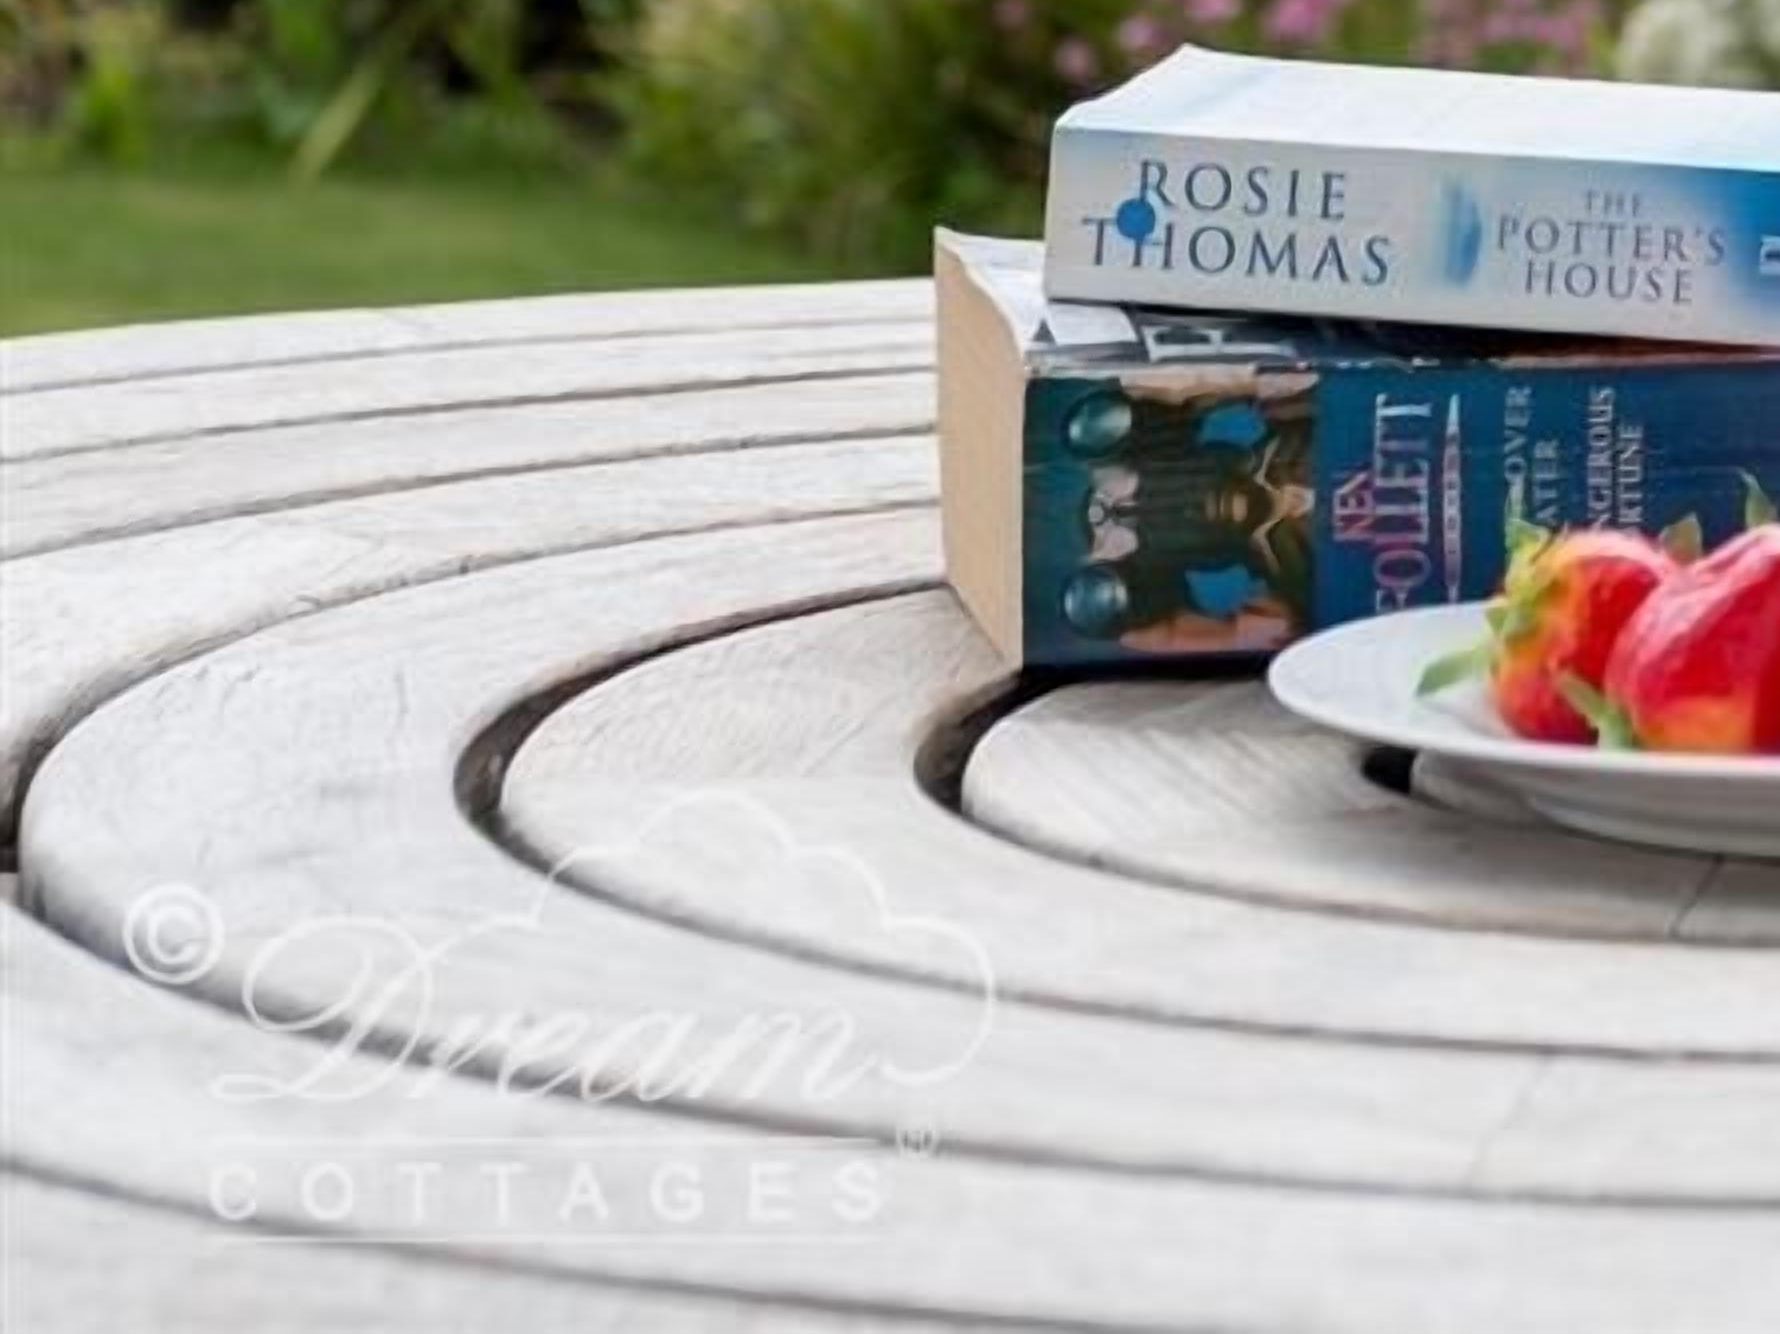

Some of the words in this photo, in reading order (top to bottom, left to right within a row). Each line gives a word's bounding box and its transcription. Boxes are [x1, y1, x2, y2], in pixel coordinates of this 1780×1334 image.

[1138, 159, 1346, 221] ROSIE
[1584, 190, 1642, 214] THE
[1081, 216, 1390, 286] THOMAS
[1498, 214, 1727, 266] POTTER'S
[1526, 260, 1694, 306] HOUSE
[1504, 386, 1532, 480] OVER
[1332, 470, 1376, 542] KEN
[1534, 438, 1560, 528] ATER
[1619, 423, 1645, 524] RTUNE
